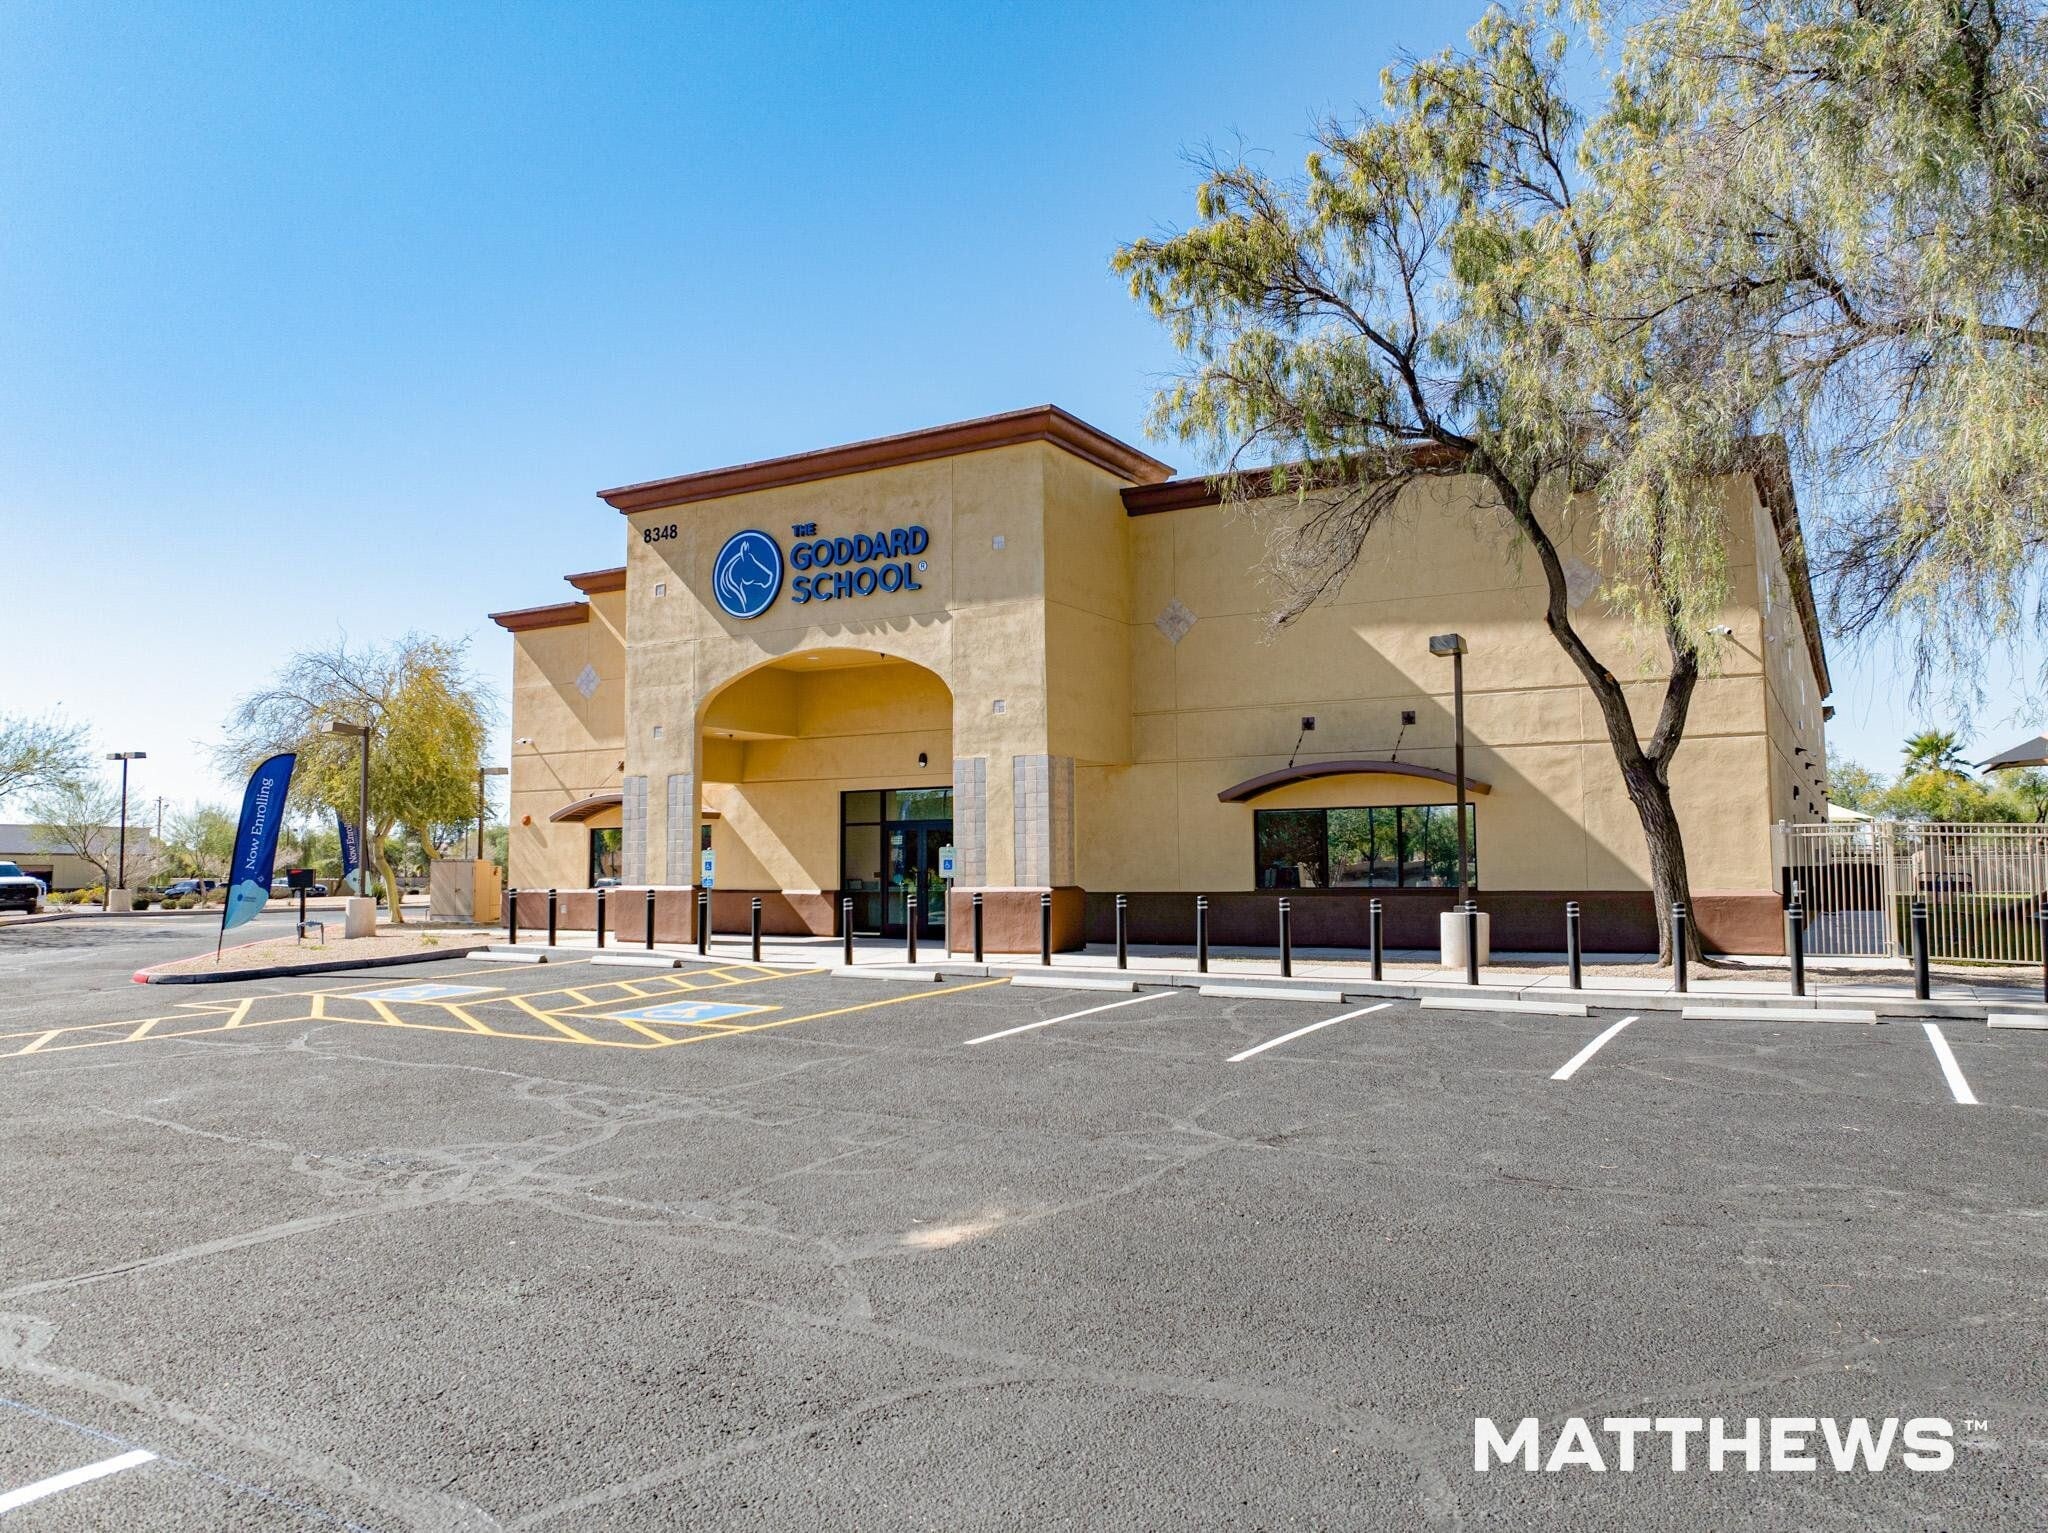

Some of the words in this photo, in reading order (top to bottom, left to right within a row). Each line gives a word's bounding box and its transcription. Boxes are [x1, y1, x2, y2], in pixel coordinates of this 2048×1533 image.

[643, 525, 678, 544] 8348
[792, 522, 817, 537] THE
[790, 526, 929, 571] GODDARD
[251, 777, 274, 835] Enrolling
[246, 838, 260, 870] Now
[348, 846, 358, 864] Now
